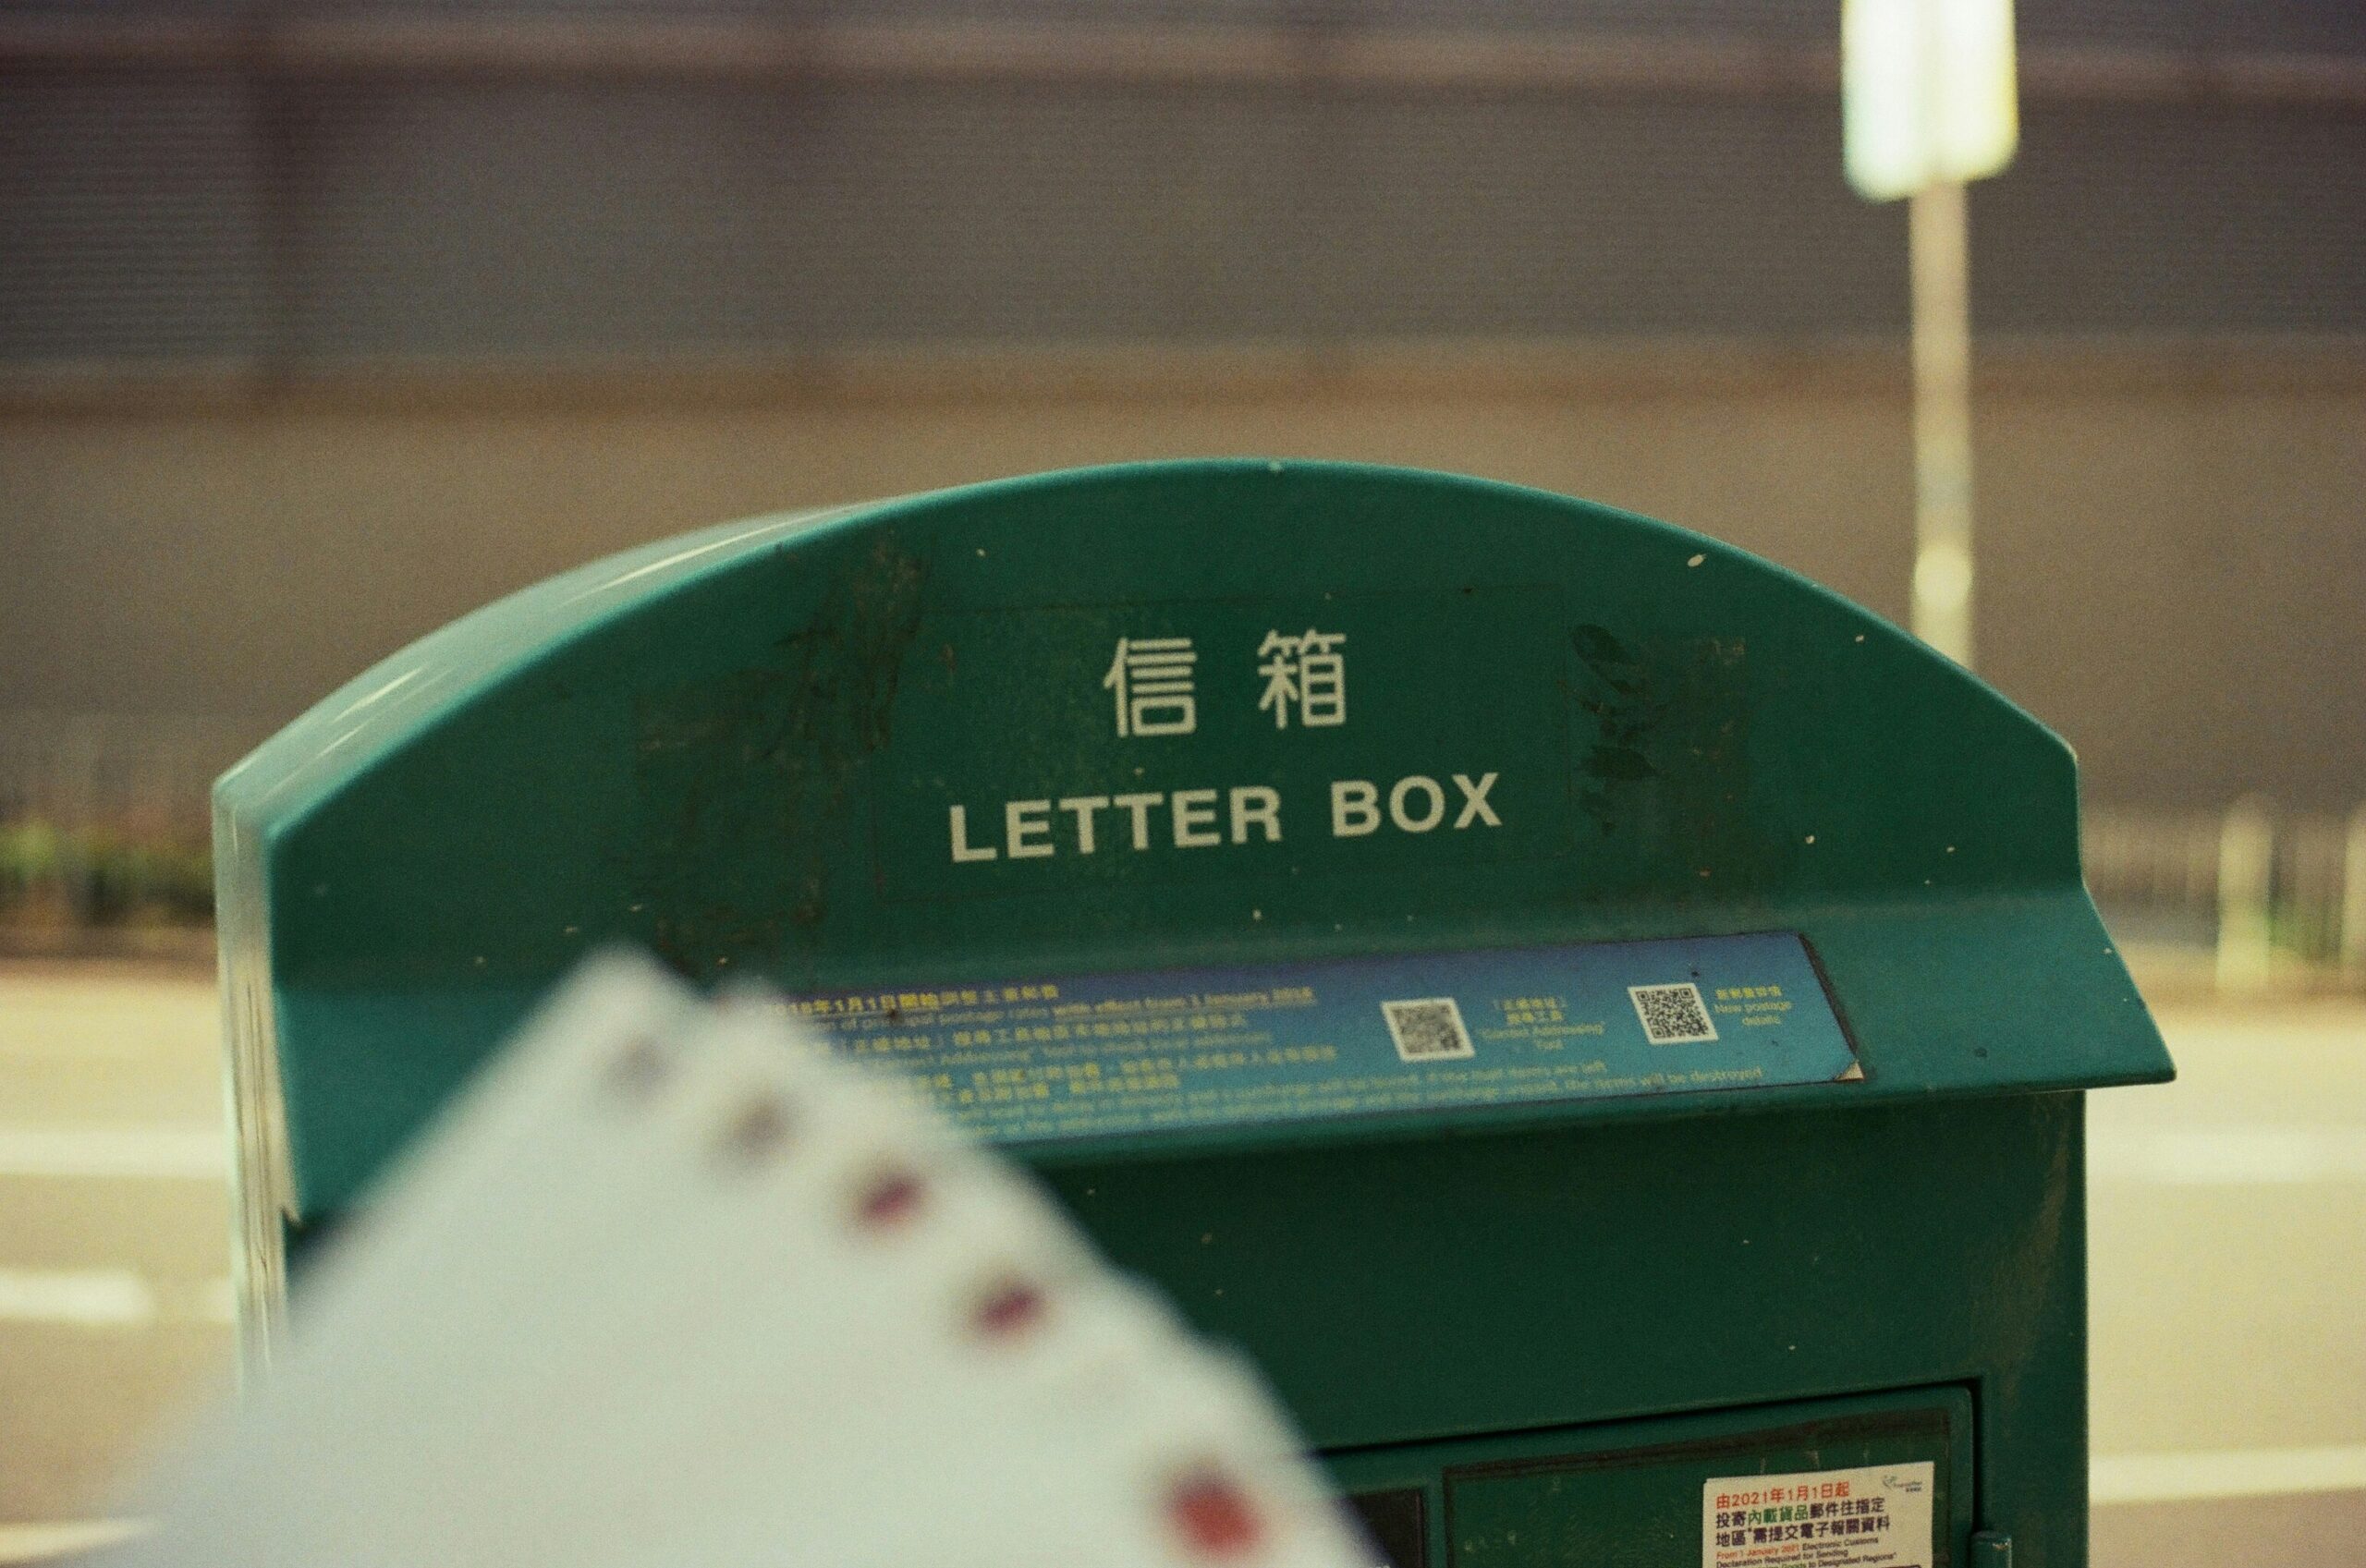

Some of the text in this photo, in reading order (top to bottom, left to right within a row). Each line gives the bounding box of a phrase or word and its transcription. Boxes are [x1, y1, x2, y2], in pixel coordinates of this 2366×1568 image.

[1103, 628, 1347, 738] 信箱
[949, 772, 1503, 863] LETTER BOX
[1716, 1481, 1850, 1510] 由2021年1月1日起
[1716, 1551, 1738, 1560] From
[1747, 1546, 1778, 1556] January
[1802, 1540, 1841, 1551] Electronic
[1844, 1537, 1878, 1547] Customs
[1716, 1558, 1762, 1568] Declaration
[1764, 1553, 1801, 1564] Required
[1816, 1550, 1848, 1560] Sending
[1818, 1556, 1861, 1568] Designated
